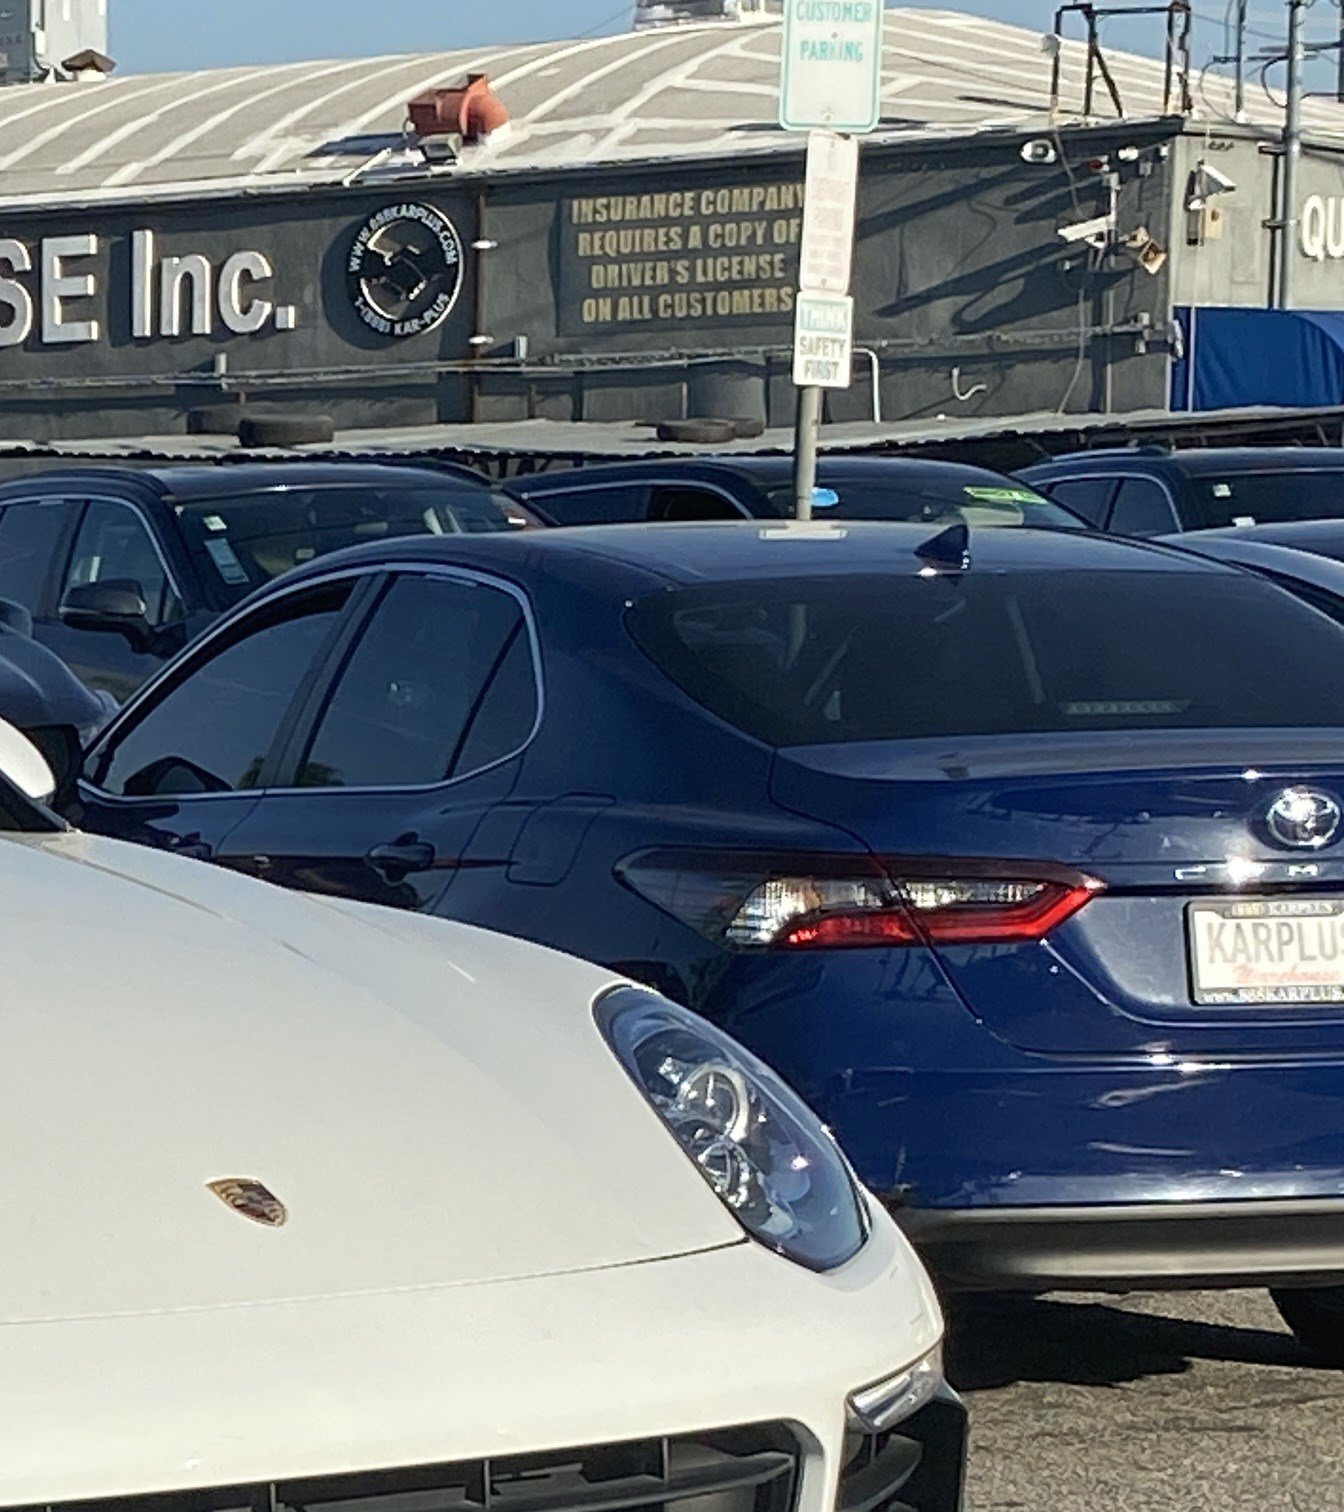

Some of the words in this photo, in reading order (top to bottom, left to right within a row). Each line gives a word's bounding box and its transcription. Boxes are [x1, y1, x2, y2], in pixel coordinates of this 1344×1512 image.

[796, 1, 872, 22] CUSTOMER
[800, 40, 864, 62] PARKING
[572, 192, 695, 224] INSURANCE
[578, 227, 683, 257] REQUIRES
[687, 225, 702, 249] A
[708, 221, 767, 248] COPY
[773, 218, 801, 244] OF
[131, 229, 296, 338] Inc.
[591, 259, 691, 289] DRIVER'S
[695, 254, 786, 283] LICENSE
[582, 298, 612, 323] ON
[617, 295, 652, 321] ALL
[657, 287, 793, 318] CUSTOMERS
[800, 336, 847, 359] SAFETY
